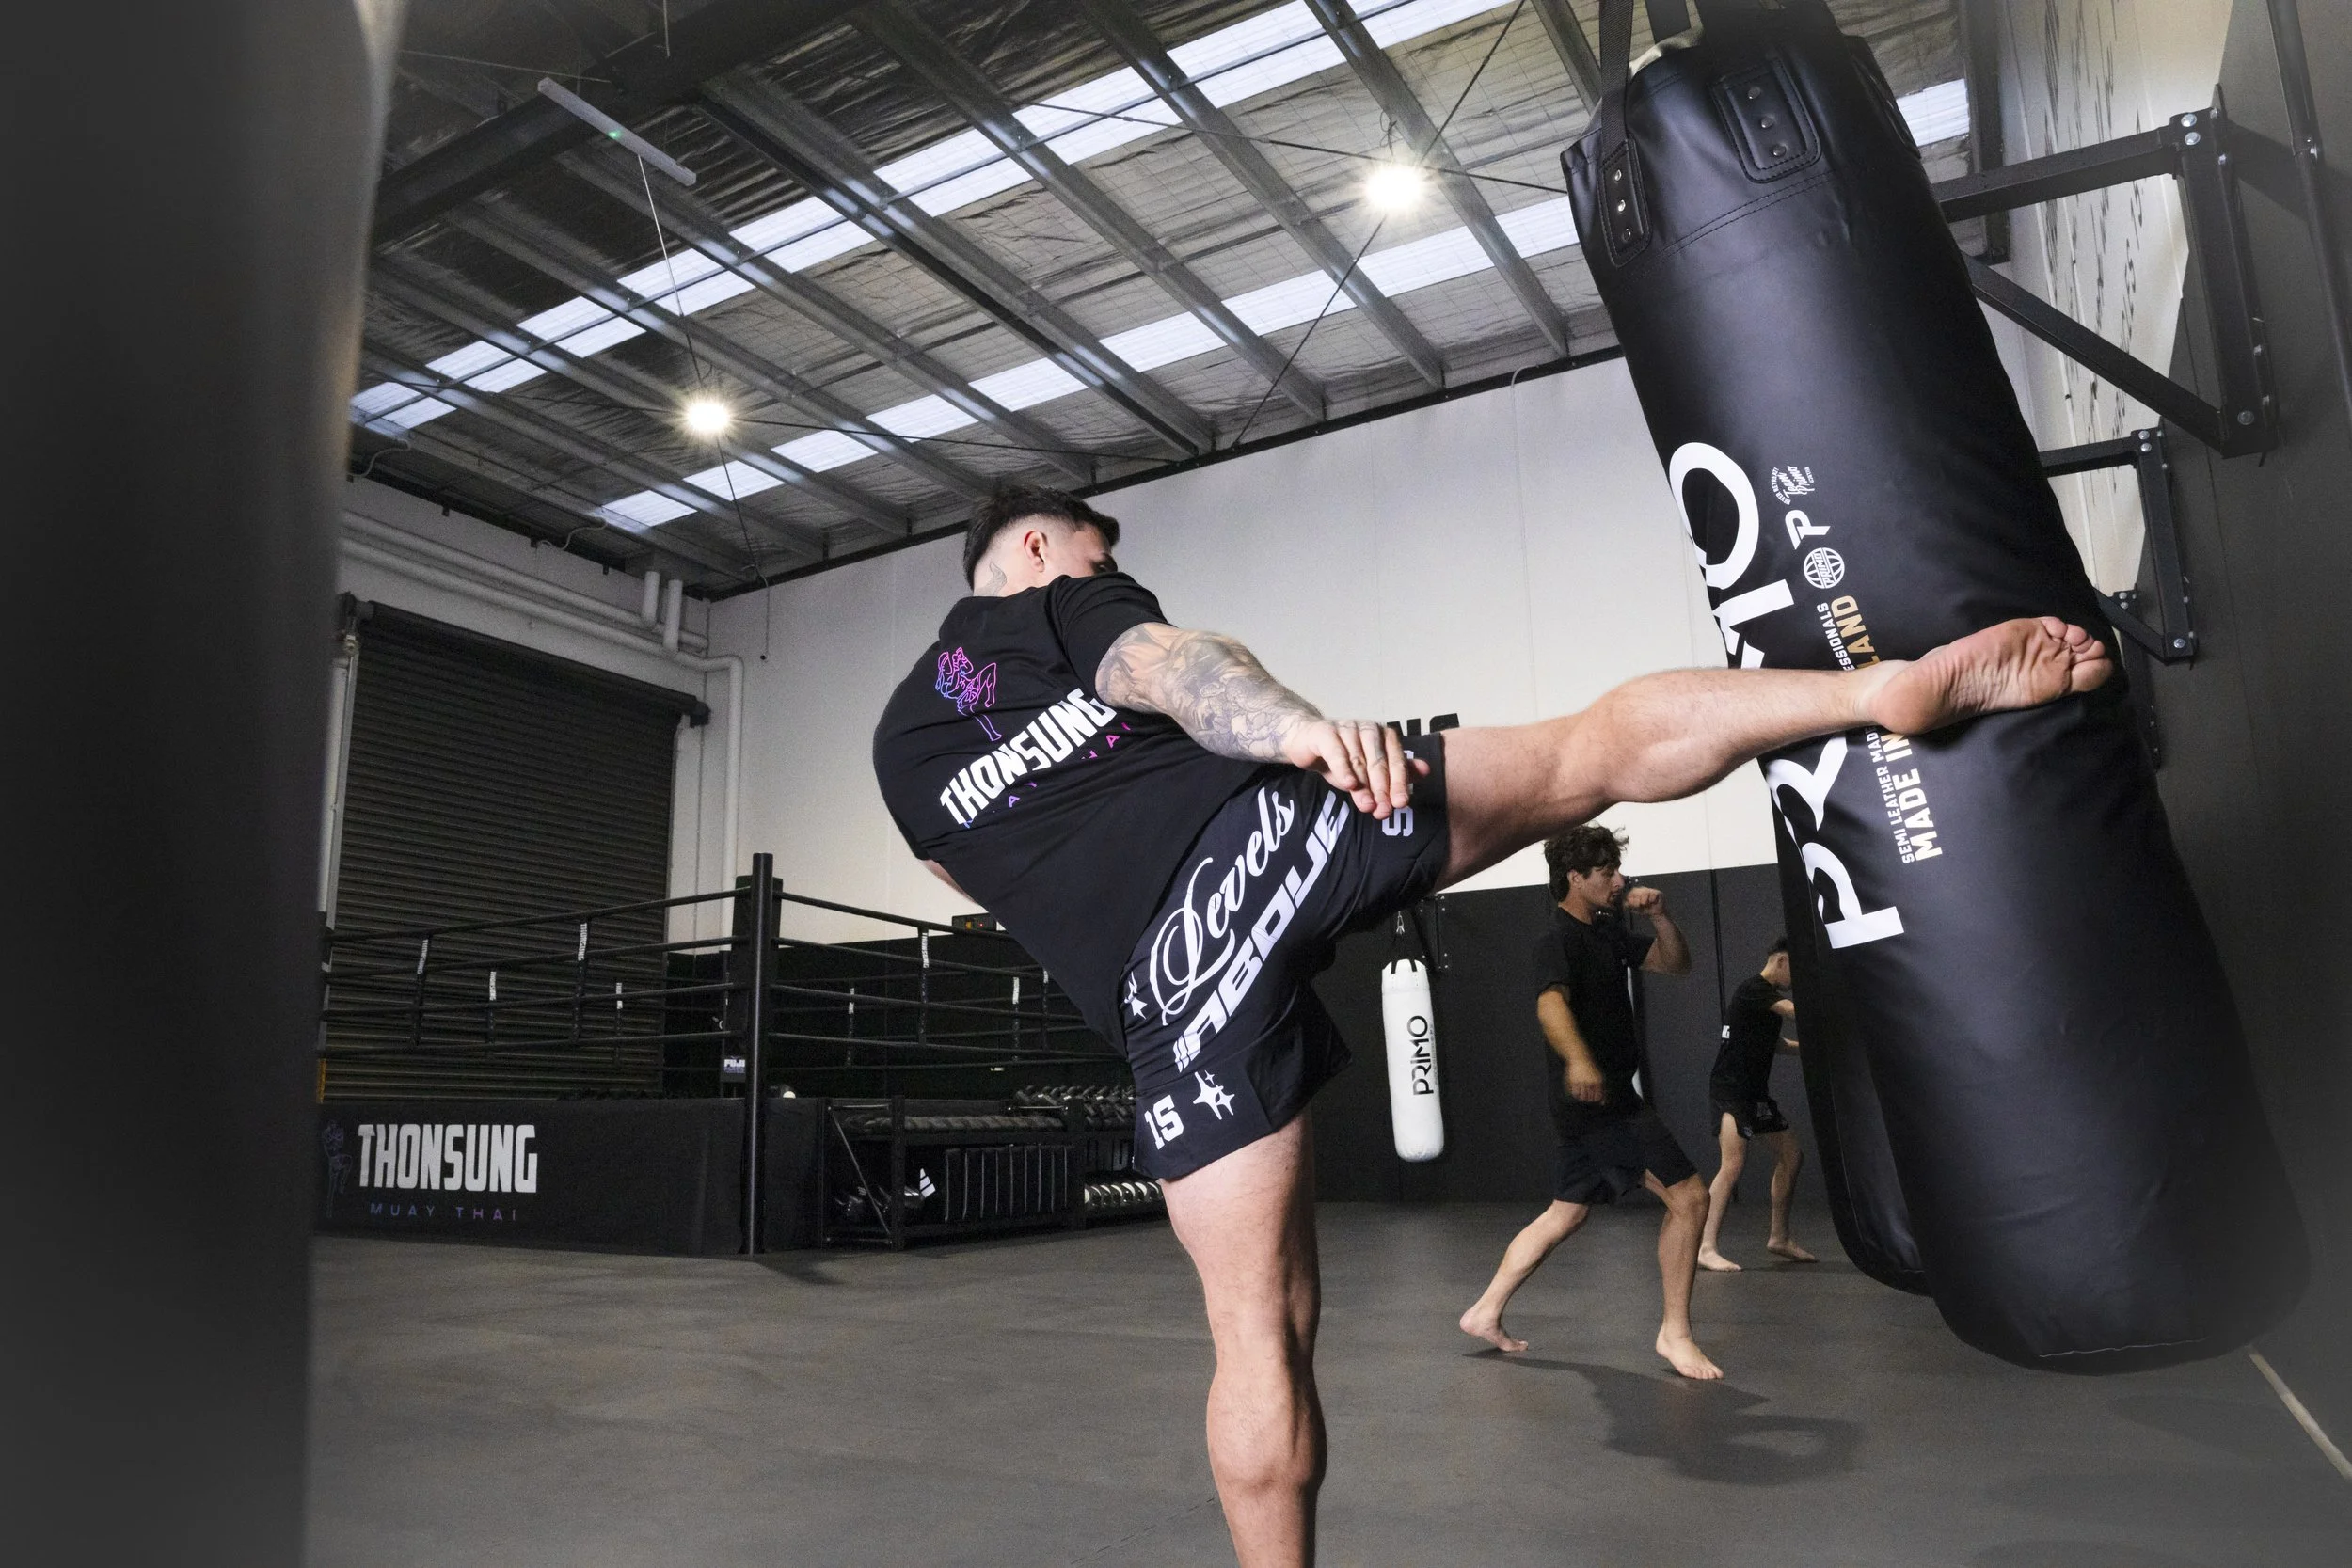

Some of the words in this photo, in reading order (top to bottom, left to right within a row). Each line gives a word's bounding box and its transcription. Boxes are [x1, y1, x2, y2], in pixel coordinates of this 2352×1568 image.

[1814, 551, 1836, 585] PRIMO
[1670, 441, 1904, 950] PRMO
[940, 687, 1117, 825] THONSUNG
[1881, 732, 1914, 763] IN
[1876, 765, 1904, 826] LEATHER
[1892, 768, 1943, 862] MADE
[1893, 828, 1915, 864] SEMI
[1150, 786, 1295, 1026] Levels
[1172, 789, 1351, 1074] ABOVE
[724, 1059, 745, 1068] FUJI
[1406, 1015, 1435, 1096] PRIMO
[358, 1124, 538, 1193] THONSUNG
[370, 1202, 436, 1217] MUAY
[455, 1206, 516, 1221] THAI
